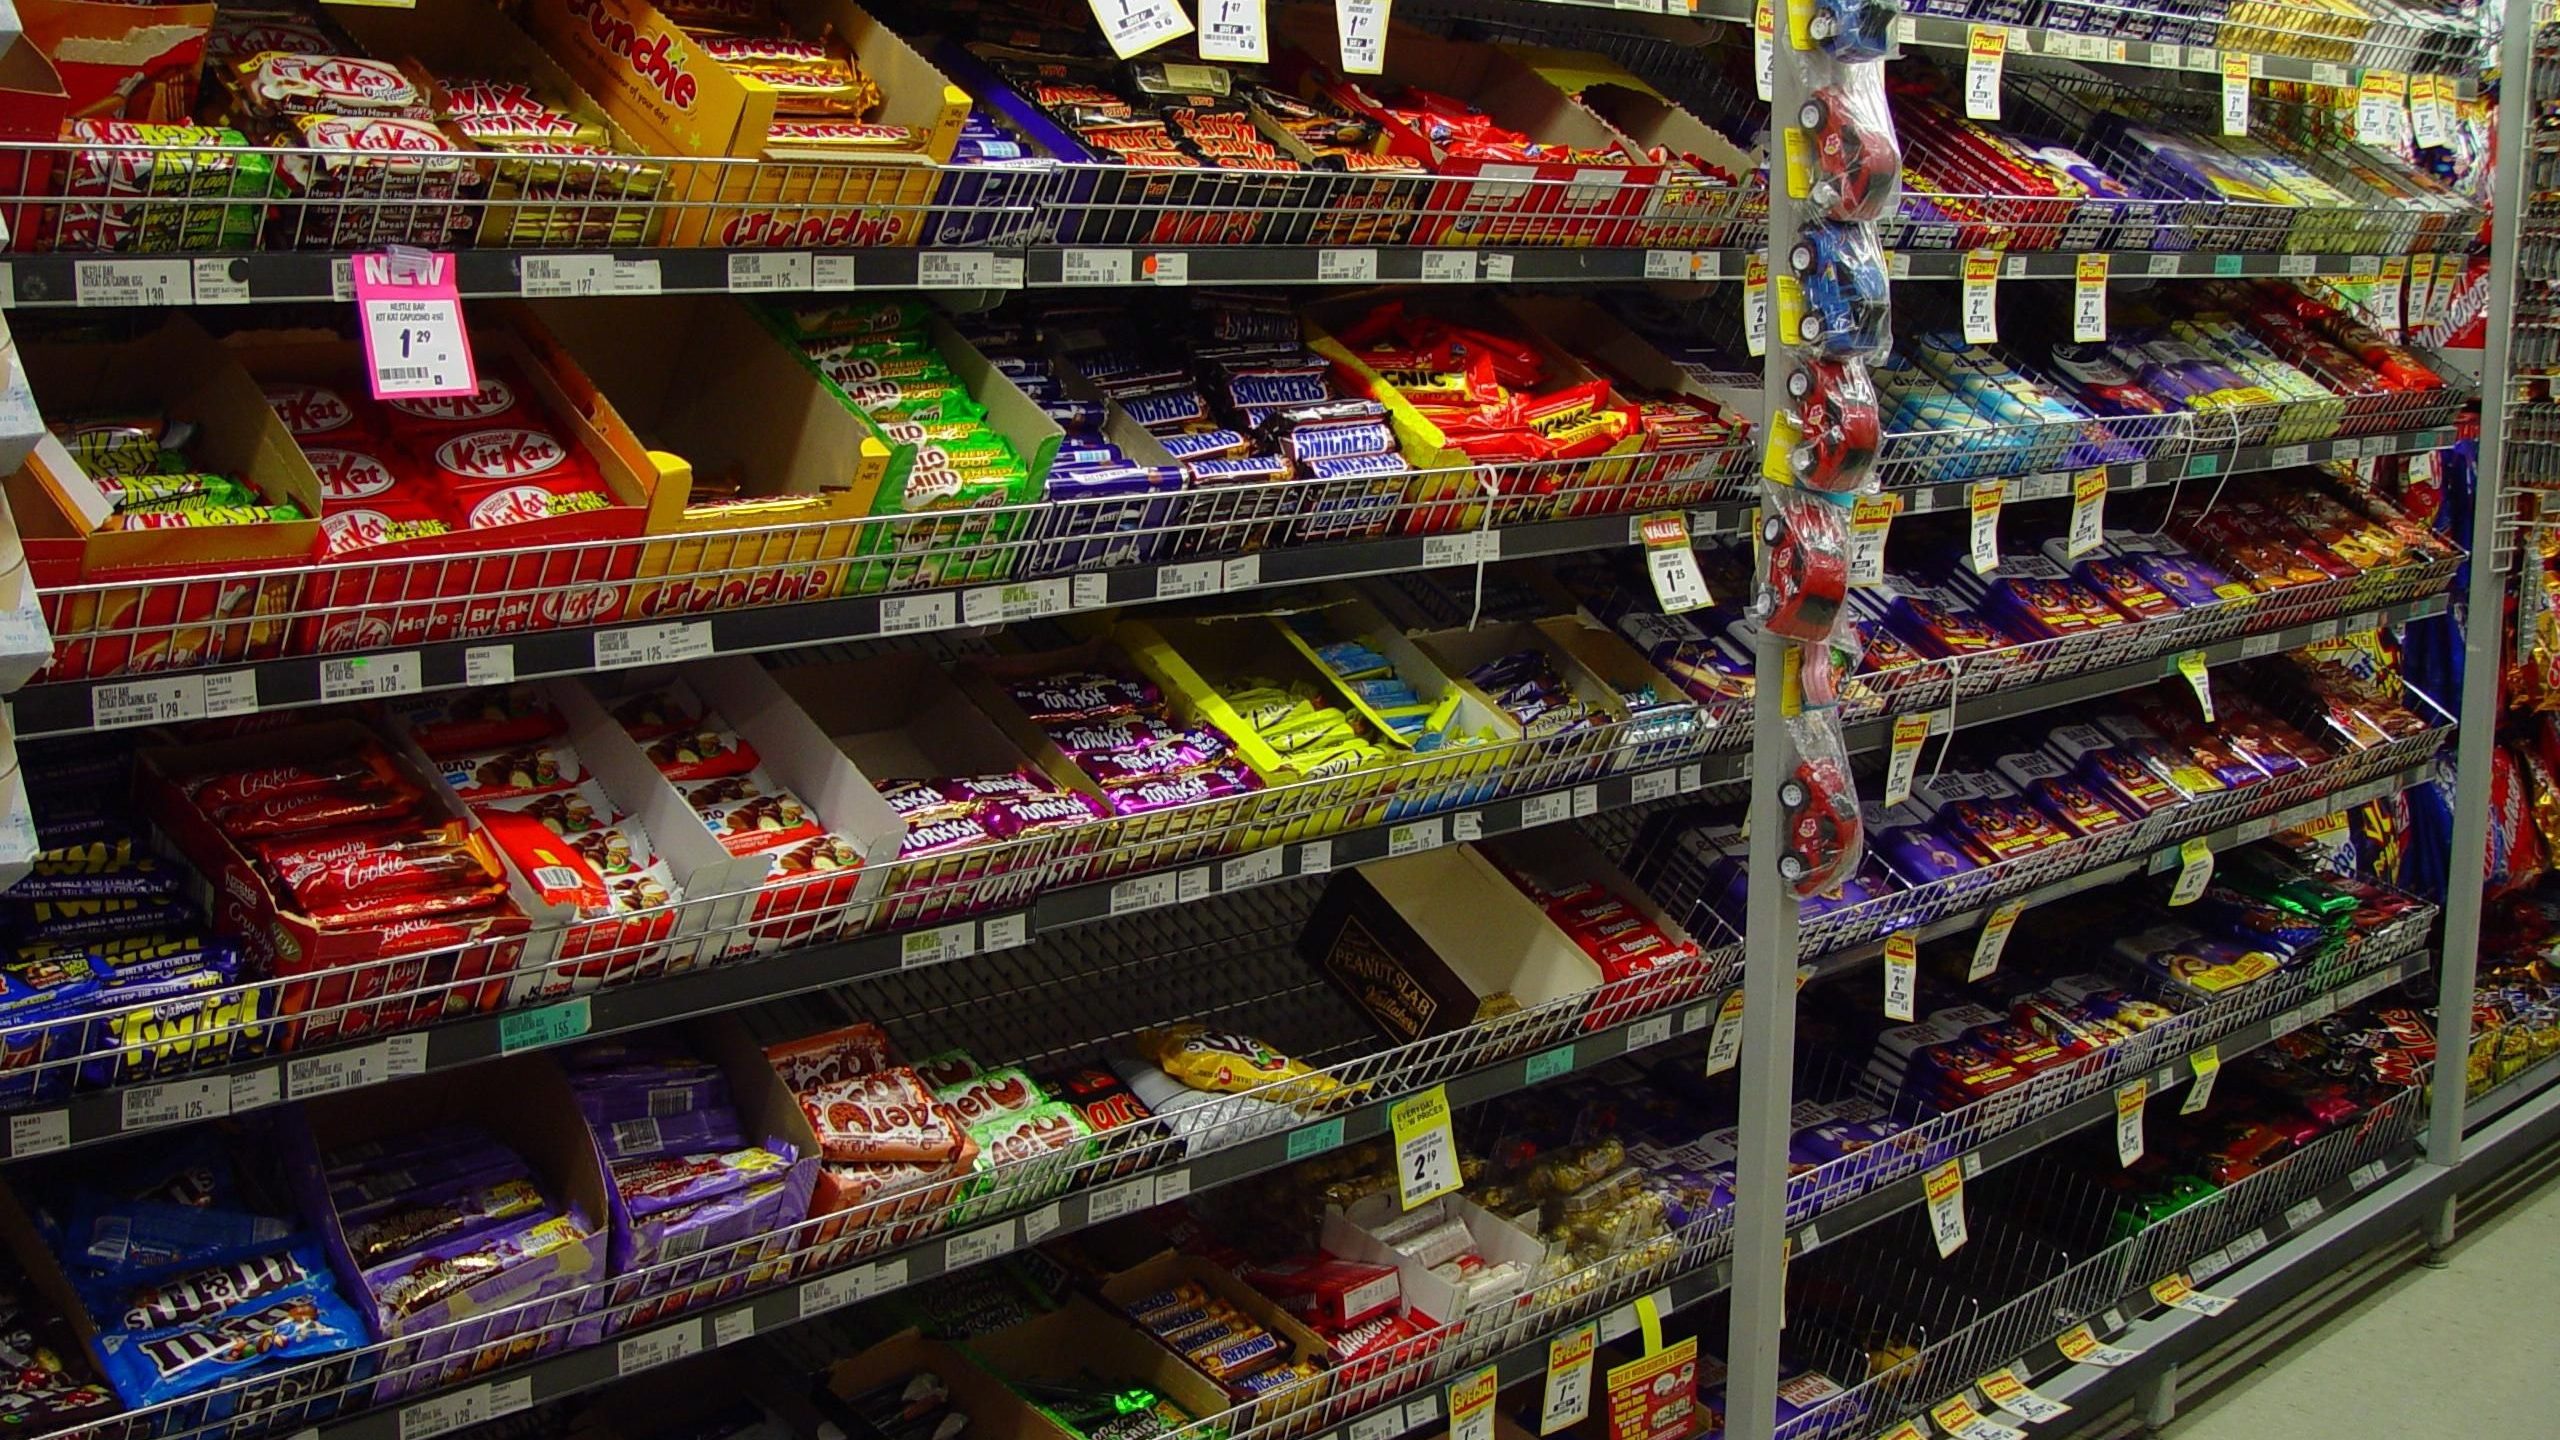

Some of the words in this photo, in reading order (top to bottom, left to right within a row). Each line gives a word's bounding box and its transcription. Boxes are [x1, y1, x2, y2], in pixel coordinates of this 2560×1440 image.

[1221, 1, 1228, 22] 1
[1232, 3, 1241, 13] 47
[1351, 15, 1358, 36] 1
[1359, 17, 1368, 27] 47
[1974, 38, 2002, 50] SPECIAL
[302, 63, 386, 93] KitKat
[1975, 75, 1983, 89] 2
[346, 122, 433, 151] KitKat
[1090, 130, 1175, 150] Mars
[1346, 154, 1421, 171] Mars
[101, 265, 114, 275] BAR
[365, 256, 445, 287] NEW
[1968, 265, 1997, 277] SPECIAL
[2079, 265, 2104, 277] SPECIAL
[413, 303, 425, 312] BAR
[1972, 300, 1979, 314] 2
[2083, 301, 2090, 314] 2
[400, 327, 411, 359] 1
[417, 329, 431, 345] 29
[827, 361, 878, 385] MILO
[1233, 375, 1325, 406] SNICKERS
[1296, 424, 1386, 459] SNICKERS
[453, 438, 559, 475] KitKat
[2079, 478, 2104, 496] SPECIAL
[1855, 505, 1890, 523] SPECIAL
[1645, 518, 1684, 540] VALUE
[1856, 543, 1864, 560] 2
[1666, 568, 1676, 593] 1
[1675, 569, 1685, 581] 25
[646, 646, 662, 662] 1.25
[380, 676, 398, 693] 1.29
[160, 702, 180, 721] 1.29
[1067, 726, 1134, 751] TURKISH
[1895, 725, 1926, 738] SPECIAL
[240, 767, 300, 797] Cookie
[1138, 777, 1209, 804] TURKISH
[1010, 795, 1091, 822] TURKISH
[345, 855, 404, 890] Cookie
[1581, 901, 1622, 918] Nougat
[1600, 918, 1641, 936] Nougat
[1619, 934, 1660, 952] Nougat
[1887, 941, 1914, 955] SPECIAL
[1649, 950, 1686, 967] Nougat
[1335, 949, 1394, 981] PEANUT
[1395, 971, 1430, 1017] SLAB
[1893, 976, 1900, 990] 2
[553, 1022, 570, 1041] 1.55
[346, 1068, 363, 1087] 1.00
[185, 1099, 204, 1119] 1.25
[826, 1100, 930, 1134] Aero
[1396, 1099, 1434, 1123] EVERYDAY
[1398, 1117, 1415, 1132] LW
[1416, 1104, 1444, 1122] PRICES
[991, 1115, 1071, 1166] Aero
[1427, 1149, 1437, 1163] 19
[1414, 1153, 1426, 1181] 2
[1928, 1171, 1960, 1195] SPECIAL
[1220, 1334, 1274, 1366] SNICKERS
[1552, 1338, 1594, 1367] SPECIAL
[1454, 1379, 1494, 1409] SPECIAL
[1560, 1384, 1567, 1401] 1
